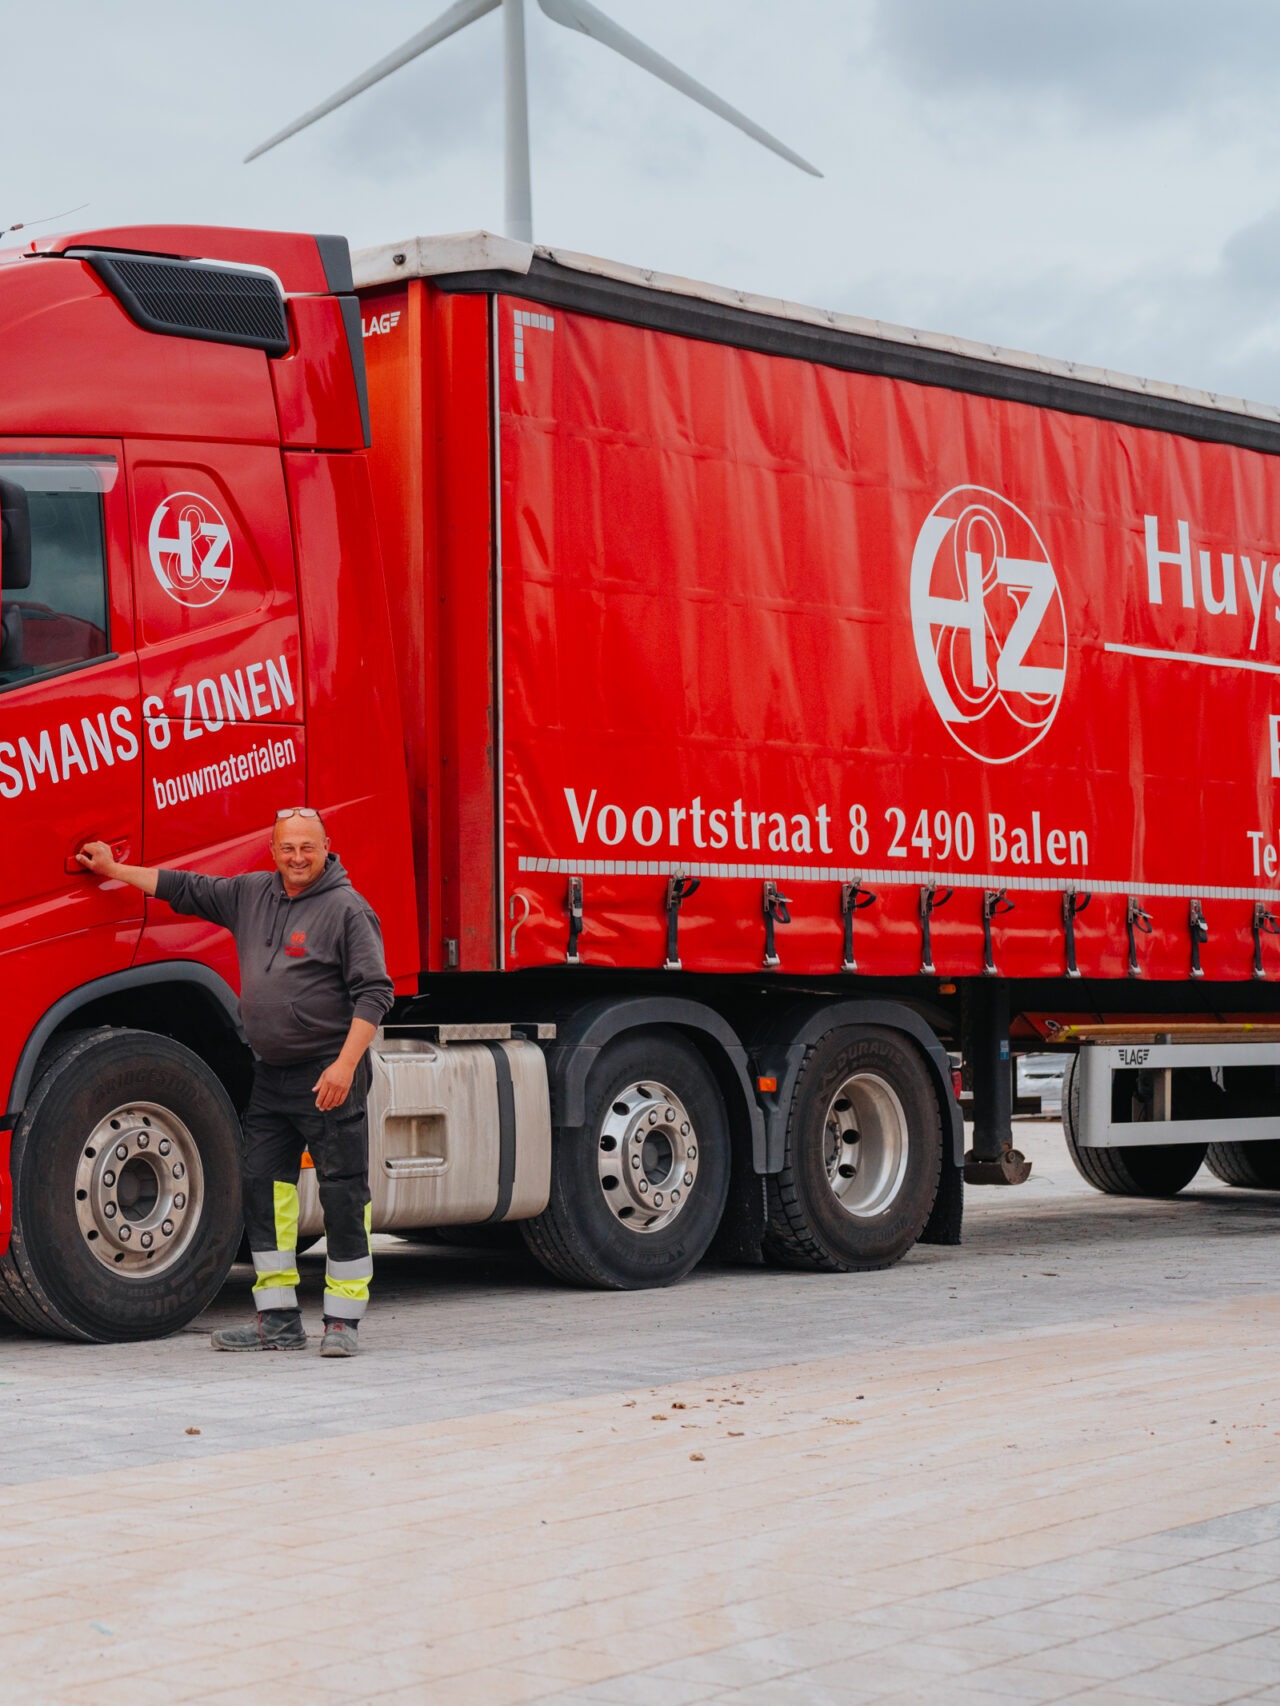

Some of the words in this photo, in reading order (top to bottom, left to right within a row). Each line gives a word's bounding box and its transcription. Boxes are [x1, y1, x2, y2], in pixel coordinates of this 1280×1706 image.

[361, 313, 391, 338] LAG
[143, 696, 171, 750] &
[174, 655, 296, 740] ZONEN
[152, 737, 297, 810] bouwmaterialen
[563, 787, 833, 855] Voortstraat
[849, 804, 870, 856] 8
[884, 807, 976, 861] 2490
[989, 811, 1089, 865] Balen
[1247, 829, 1280, 878] Te
[1124, 1049, 1143, 1065] LAG
